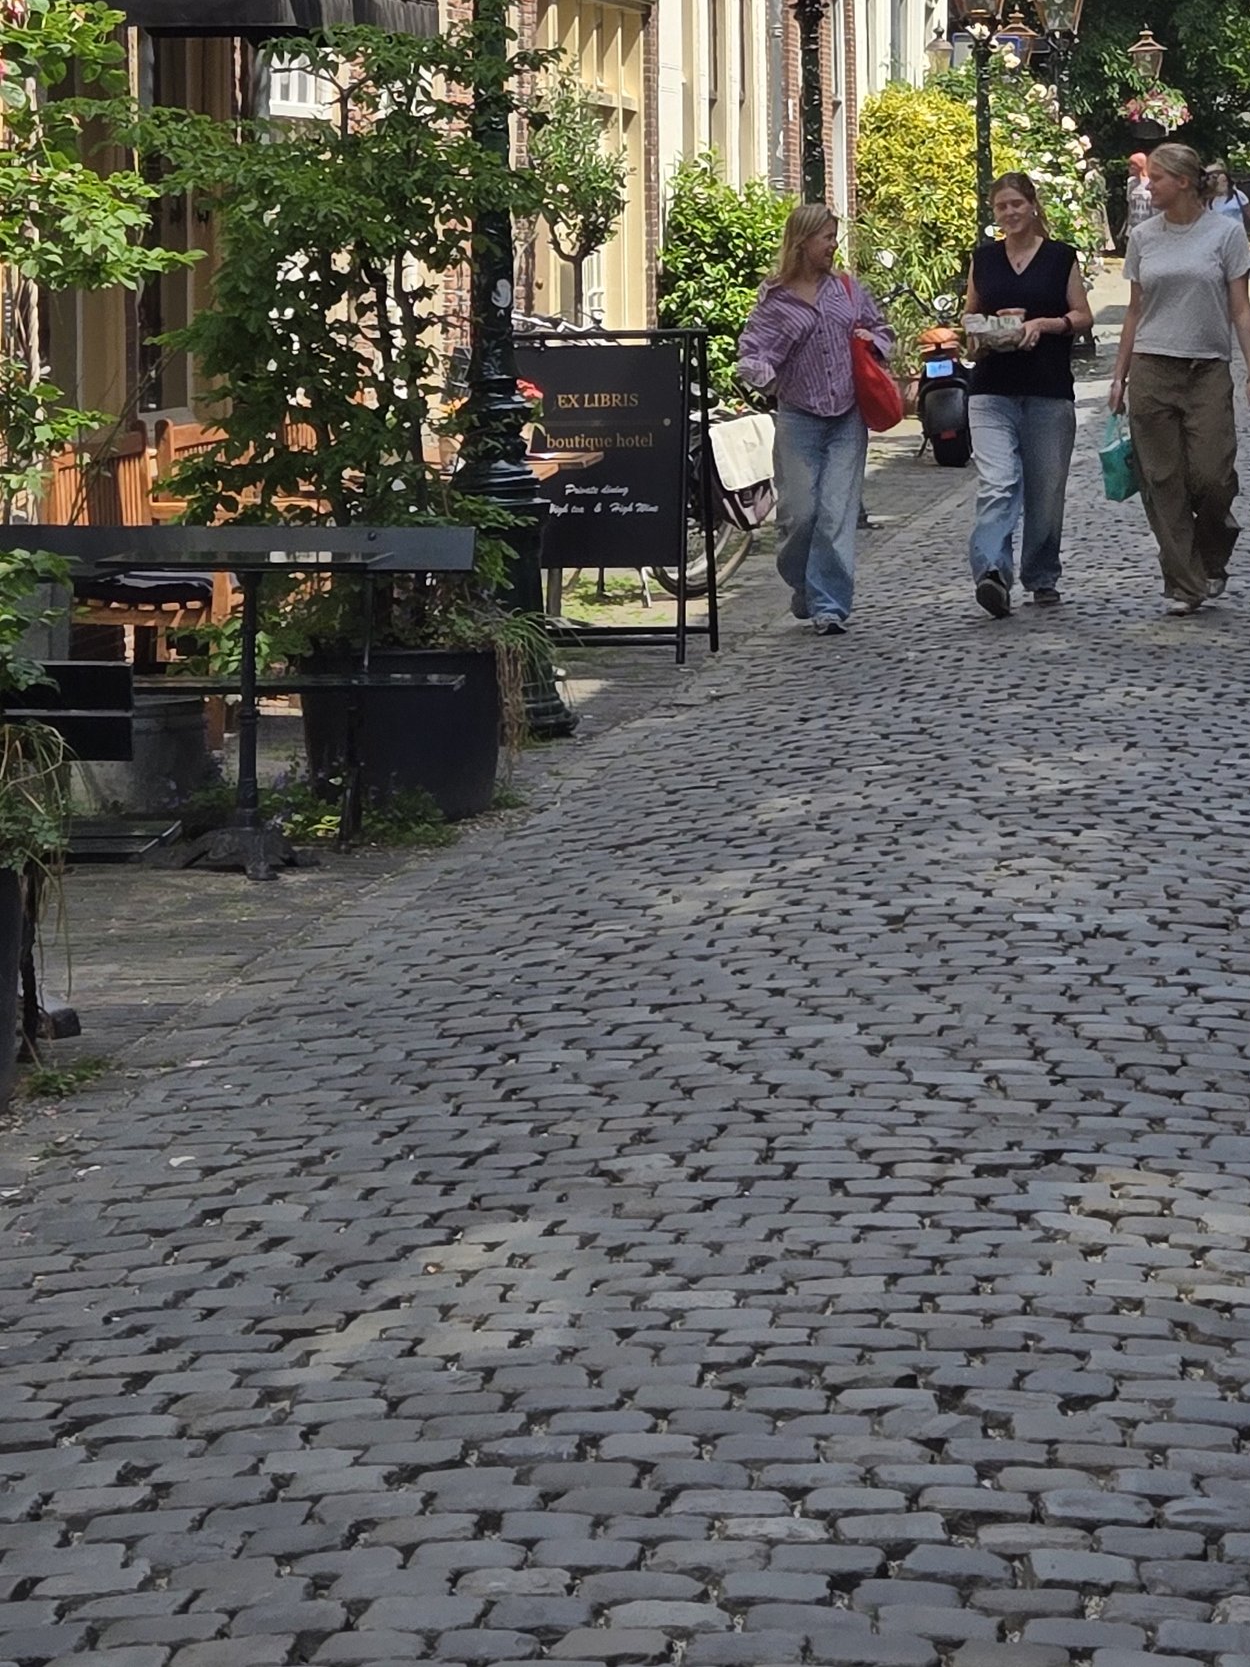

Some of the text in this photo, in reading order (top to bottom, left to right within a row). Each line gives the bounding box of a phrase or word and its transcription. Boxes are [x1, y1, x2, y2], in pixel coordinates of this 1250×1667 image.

[557, 393, 639, 409] EX LIBRIS
[546, 432, 653, 451] boutique hotel
